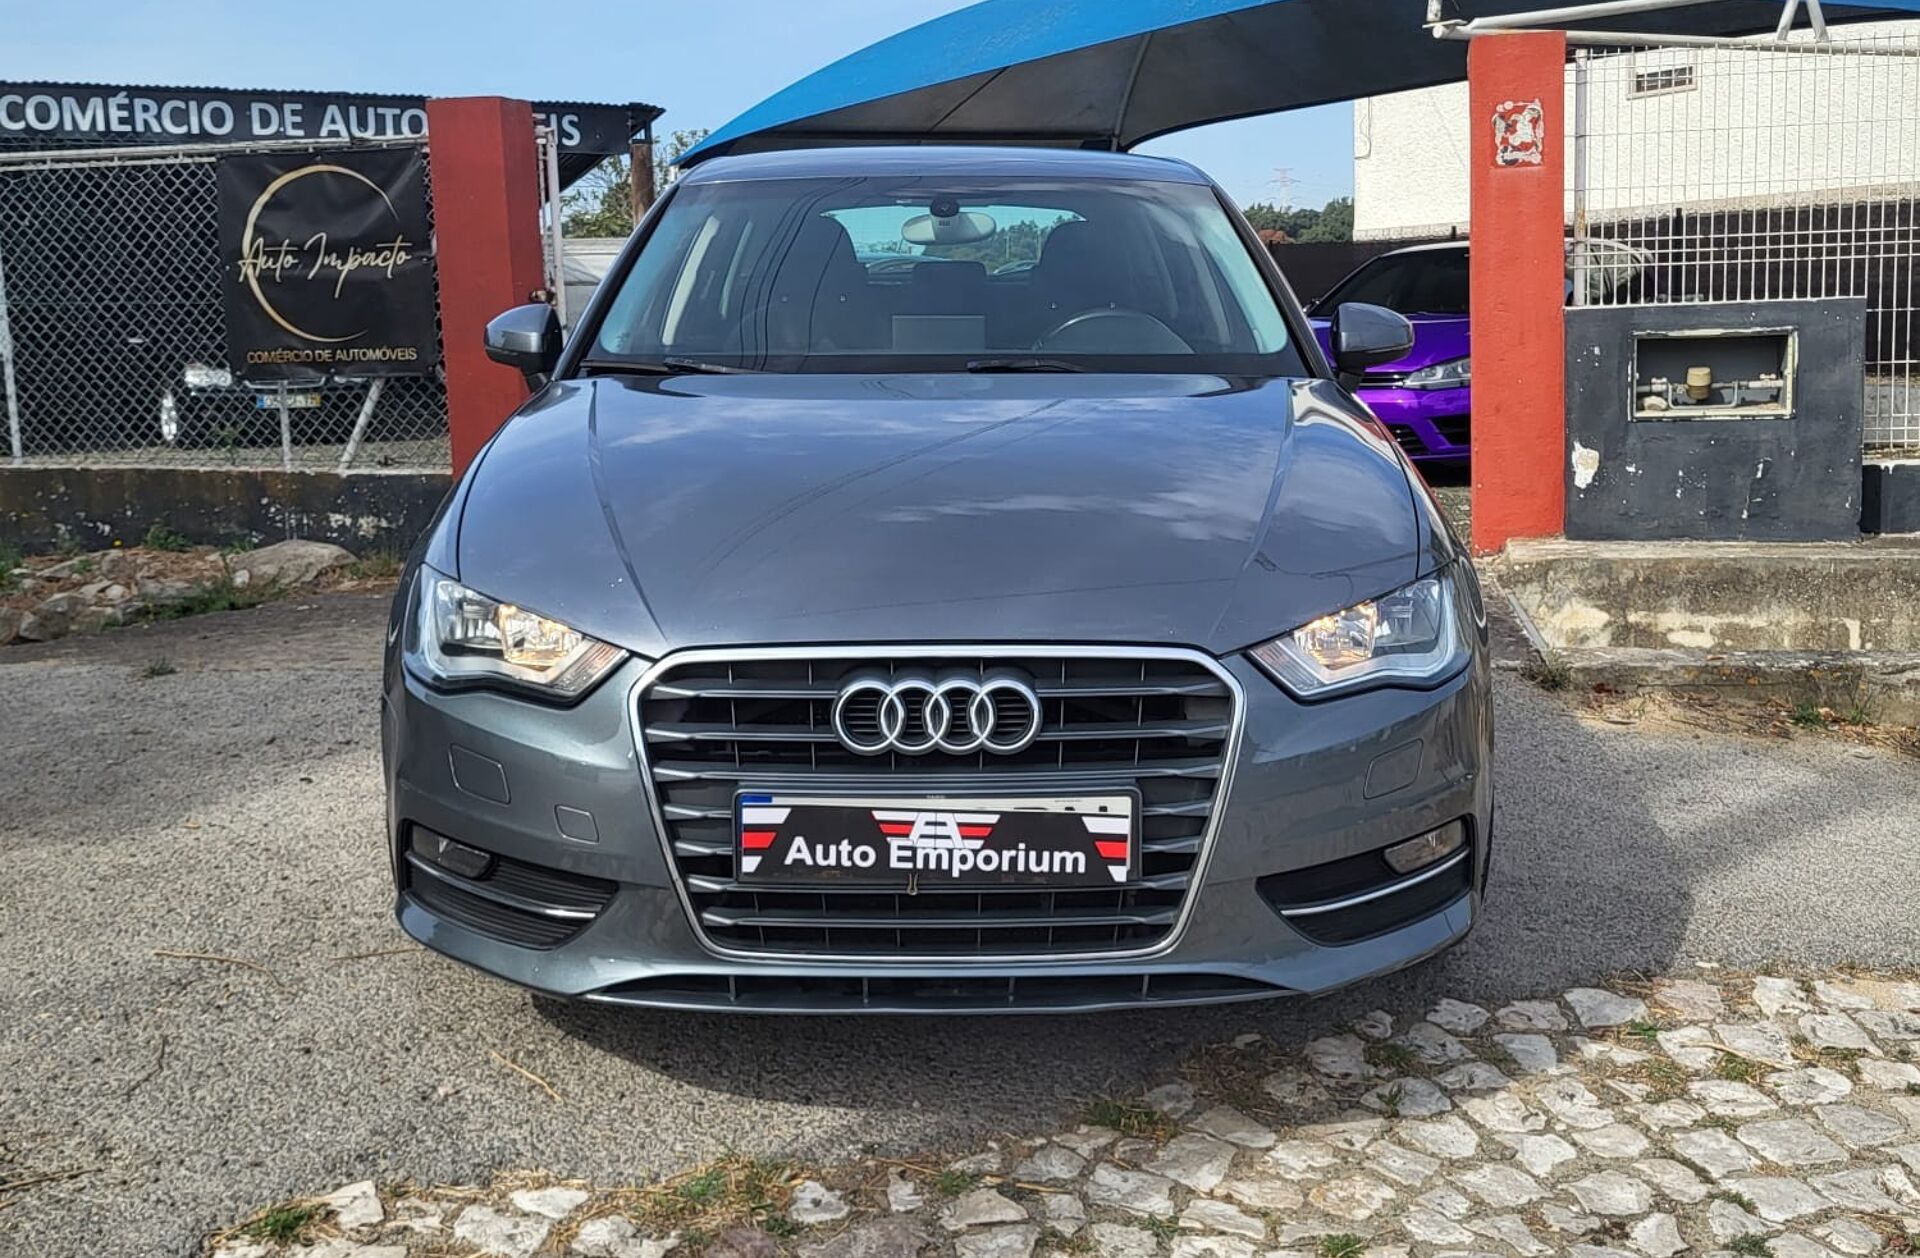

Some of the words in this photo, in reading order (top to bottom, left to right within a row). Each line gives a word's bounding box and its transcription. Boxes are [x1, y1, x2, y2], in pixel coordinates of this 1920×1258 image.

[0, 91, 235, 136] COMÉRCIO
[250, 102, 305, 136] DE
[238, 237, 299, 283] Auto
[303, 232, 413, 299] Impacto
[247, 348, 312, 364] COMÉRCIO
[315, 350, 333, 362] DE
[335, 346, 417, 362] AUTOMÓVEIS
[784, 836, 877, 868] Auto
[889, 839, 1086, 878] Emporium
